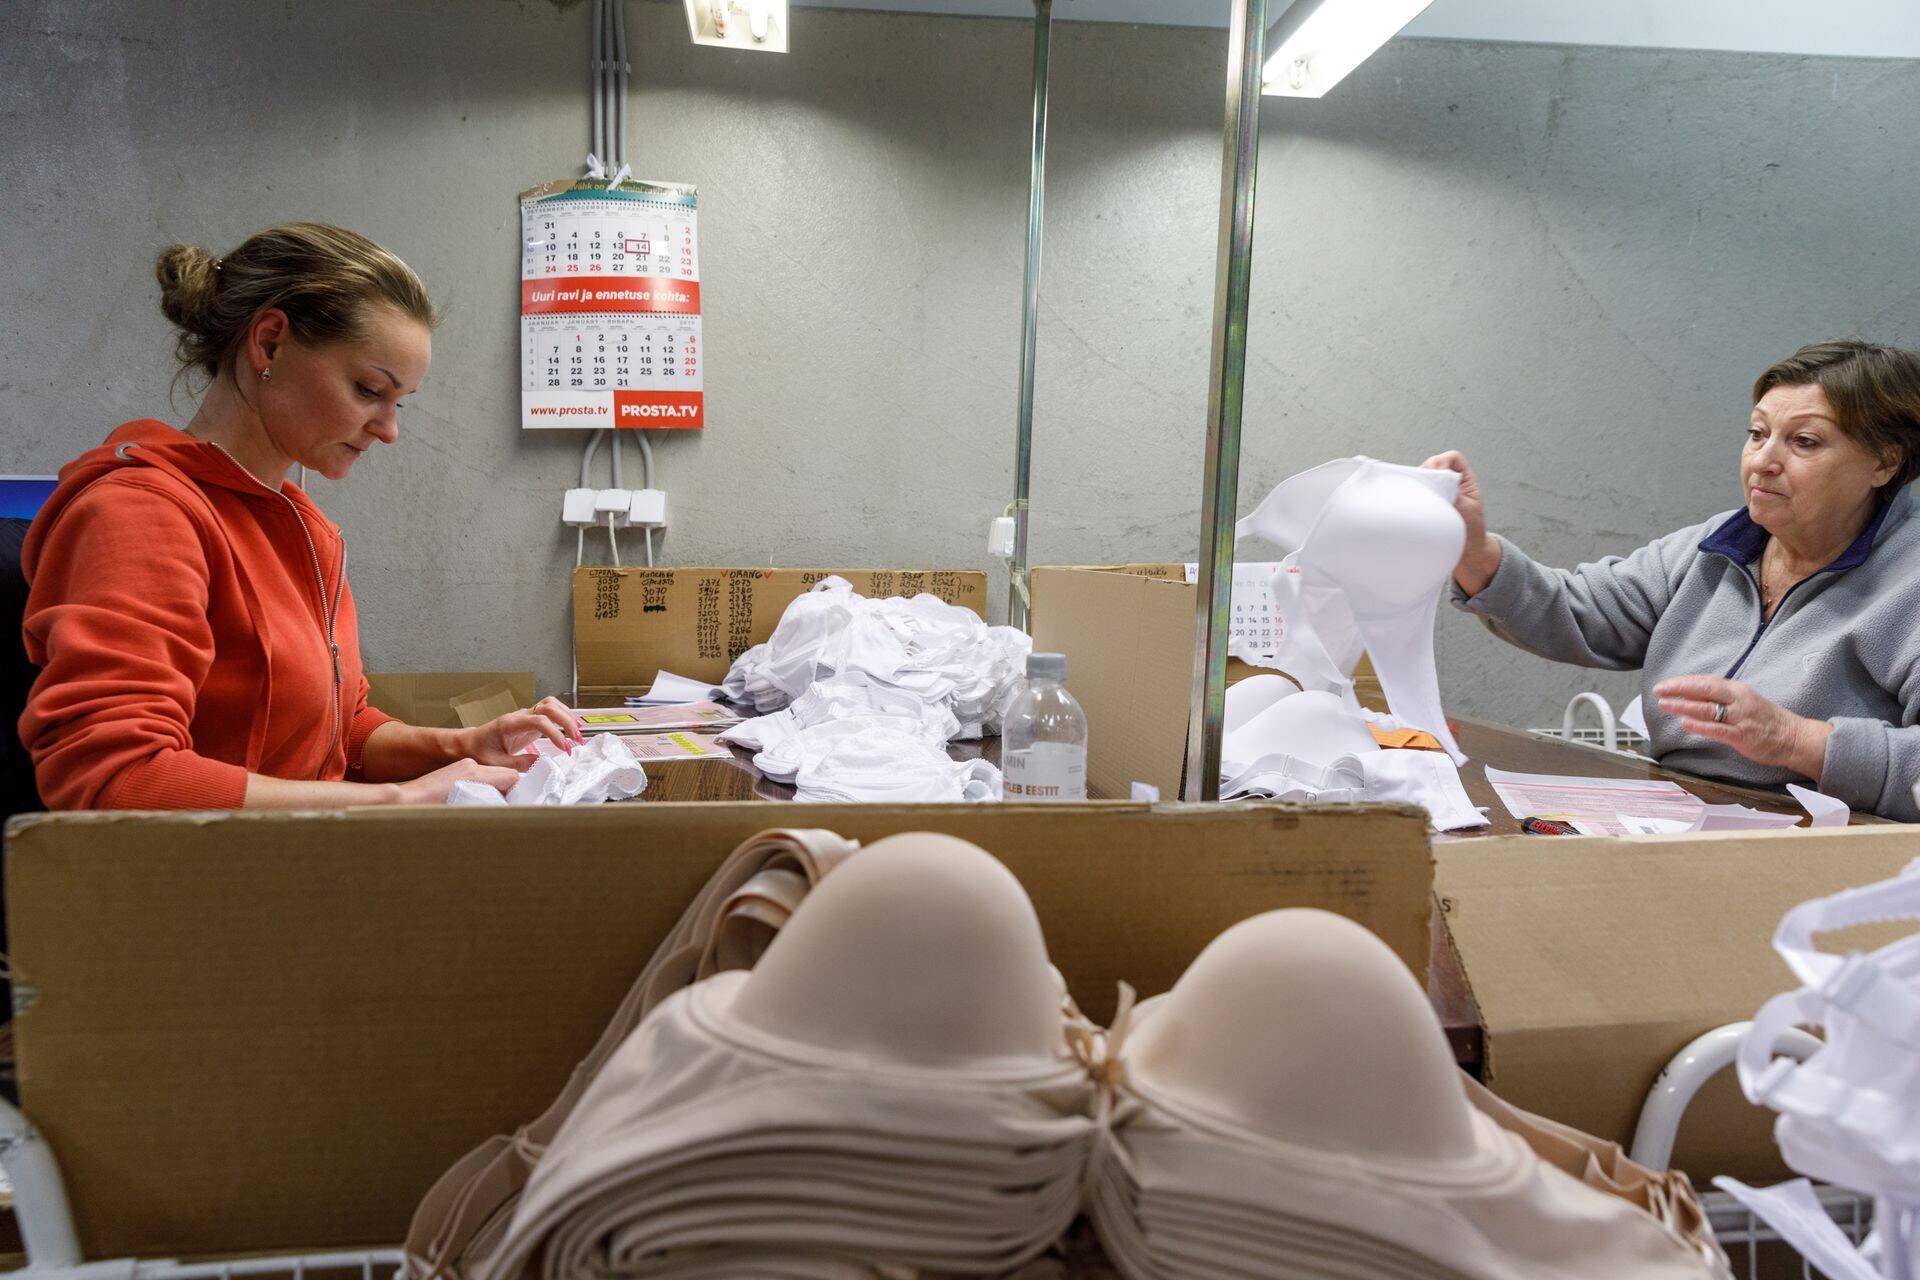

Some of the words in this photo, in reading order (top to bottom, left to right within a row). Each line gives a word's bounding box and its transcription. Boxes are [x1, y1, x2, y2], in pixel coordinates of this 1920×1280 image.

[635, 242, 648, 251] 14
[634, 253, 648, 261] 21
[532, 290, 555, 302] Uuri
[558, 291, 579, 301] ravi
[580, 289, 593, 303] ja
[596, 290, 650, 301] ennetuse
[653, 290, 690, 303] kohta:
[530, 406, 609, 416] www.prosta.tv
[621, 405, 698, 417] PROSTA.TV
[1274, 629, 1283, 637] 23
[1025, 784, 1060, 796] EESTIT
